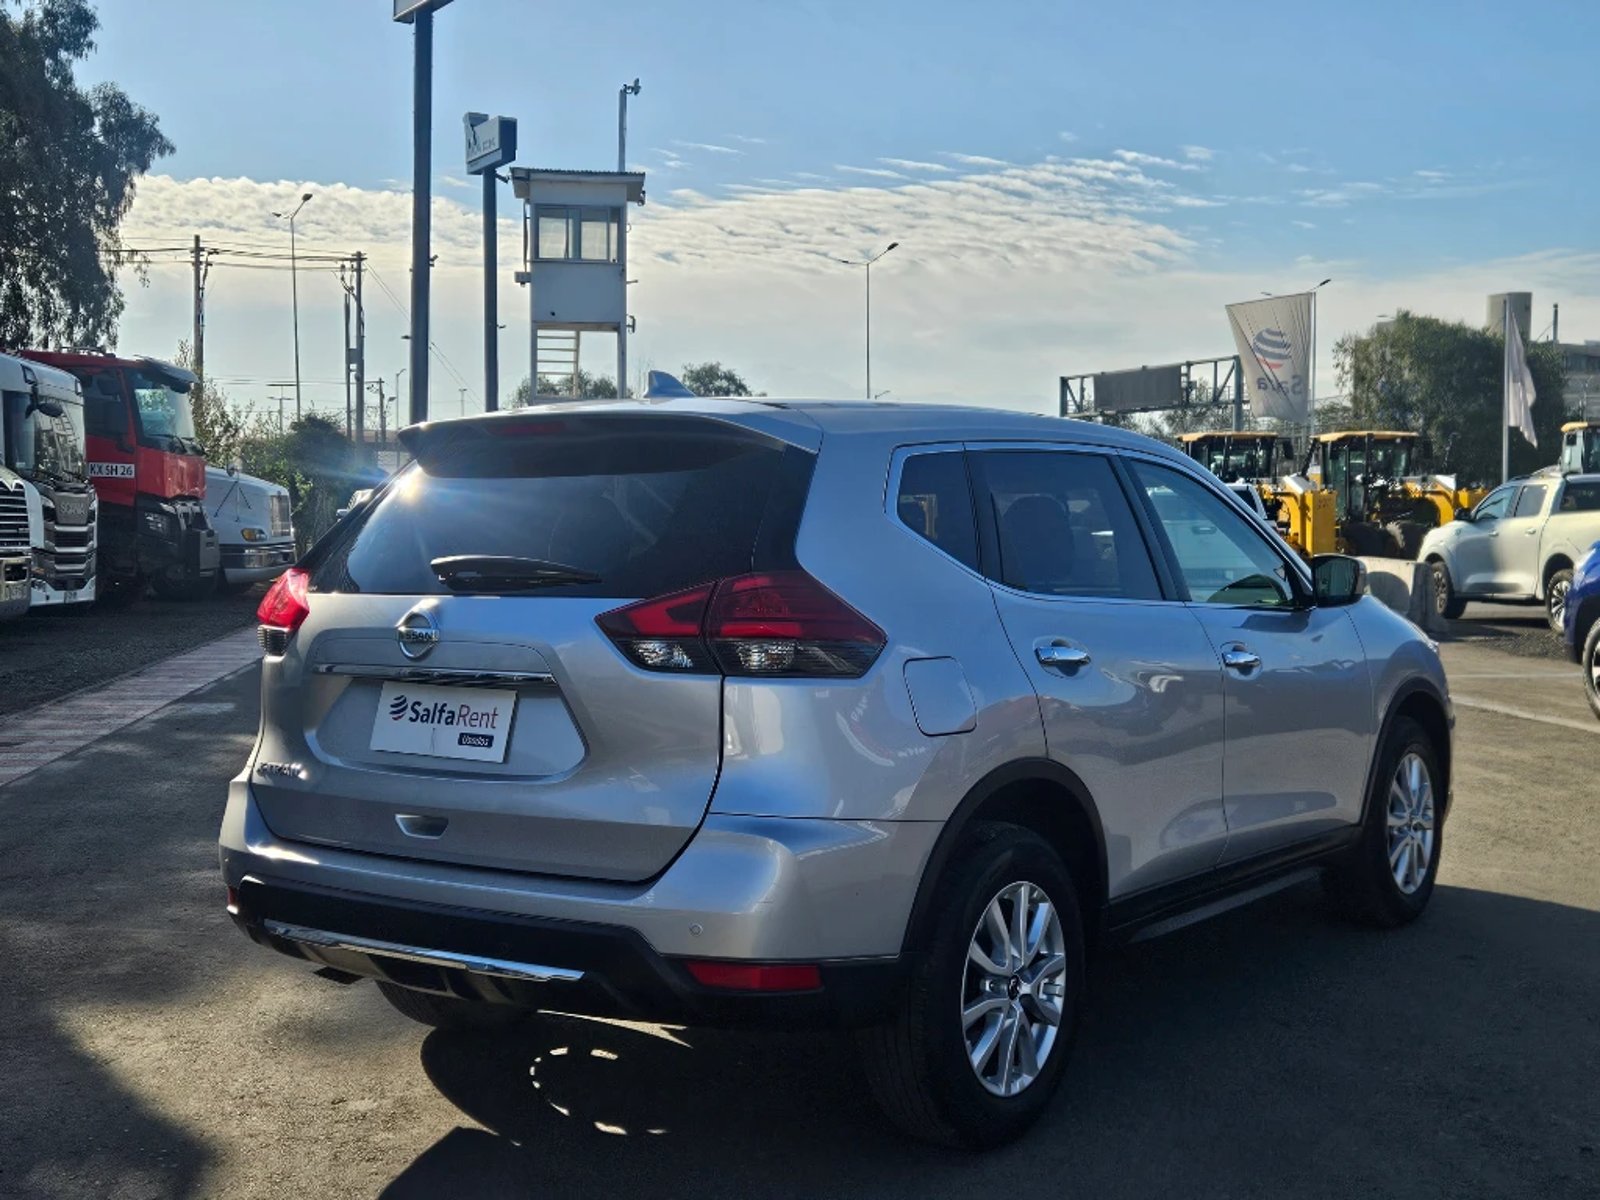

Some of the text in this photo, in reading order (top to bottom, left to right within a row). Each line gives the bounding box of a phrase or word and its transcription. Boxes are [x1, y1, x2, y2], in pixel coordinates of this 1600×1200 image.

[90, 464, 133, 476] KX SH 26
